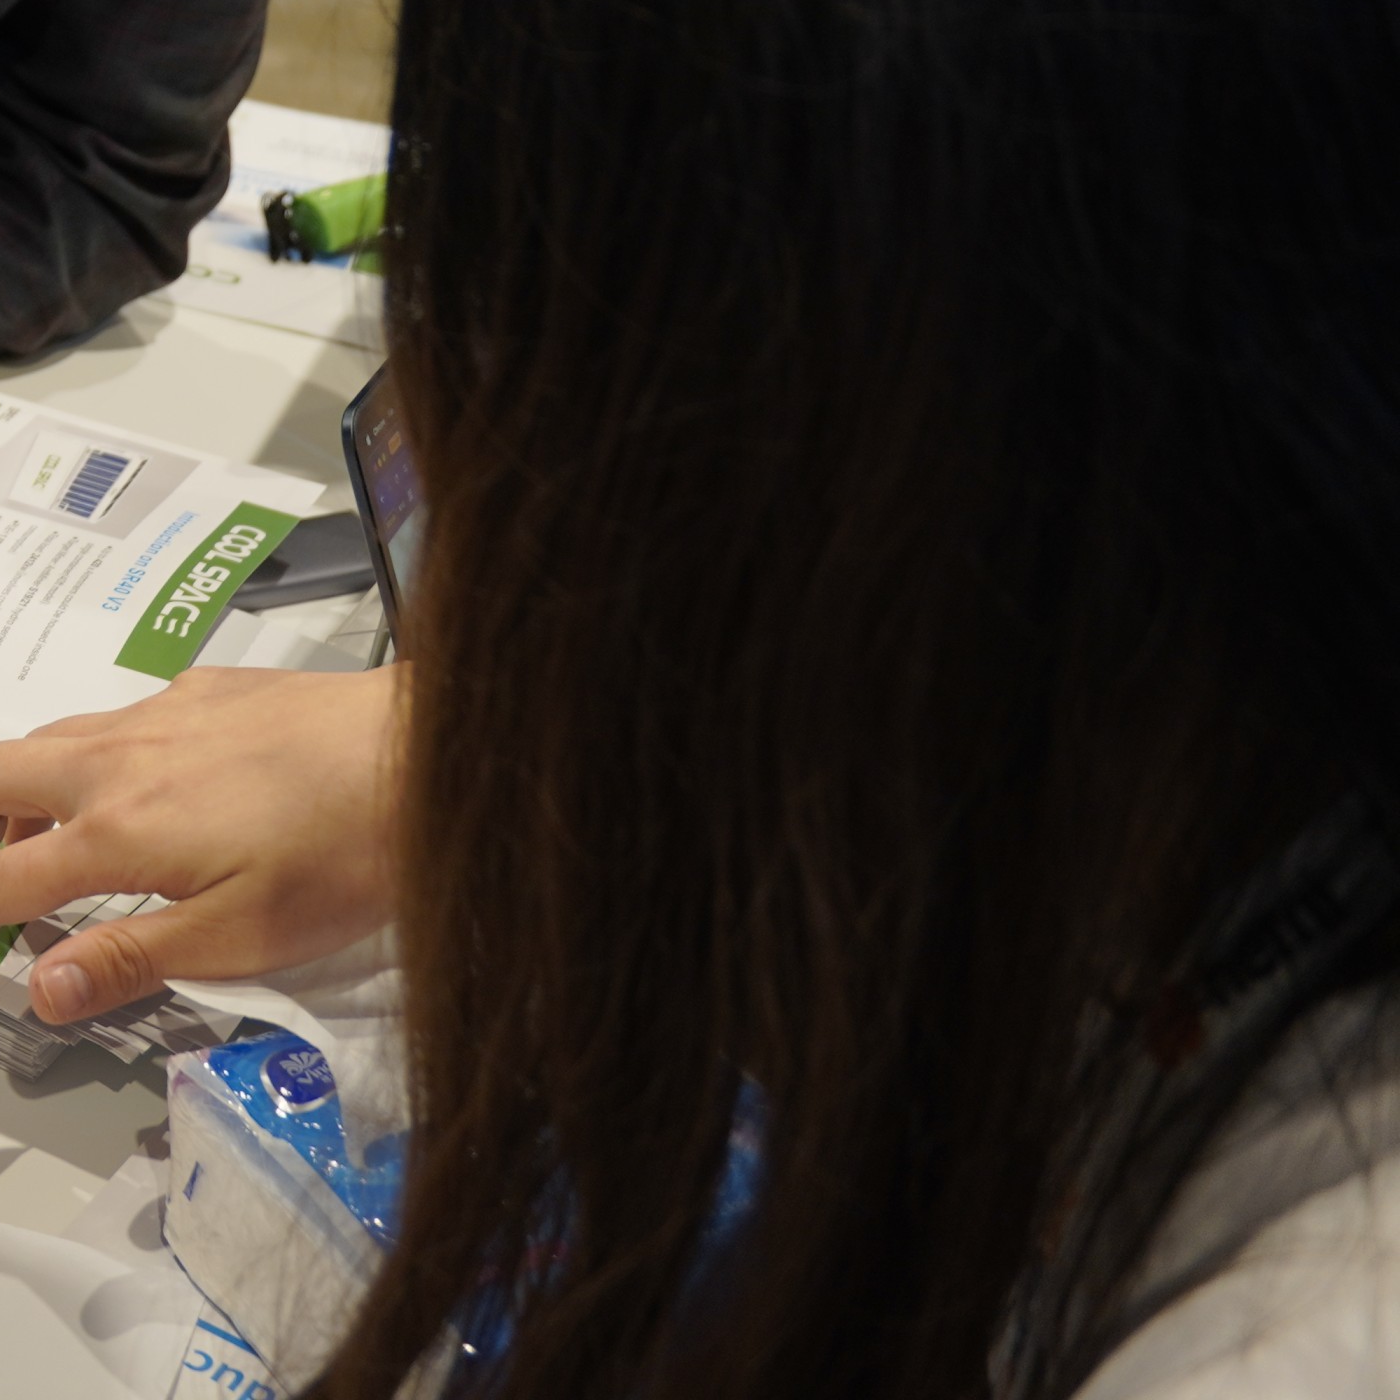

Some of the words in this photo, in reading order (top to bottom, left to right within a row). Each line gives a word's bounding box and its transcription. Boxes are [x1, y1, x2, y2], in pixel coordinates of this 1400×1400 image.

[145, 514, 193, 554] Introduction
[203, 524, 267, 563] COOL
[136, 555, 152, 567] on
[114, 568, 145, 594] SR40
[19, 587, 38, 607] S19/21
[58, 595, 73, 610] could
[102, 597, 124, 611] V3
[152, 561, 231, 638] SPACE
[6, 608, 23, 625] hydro
[38, 619, 58, 643] housed
[26, 643, 42, 665] inside
[18, 666, 30, 681] one
